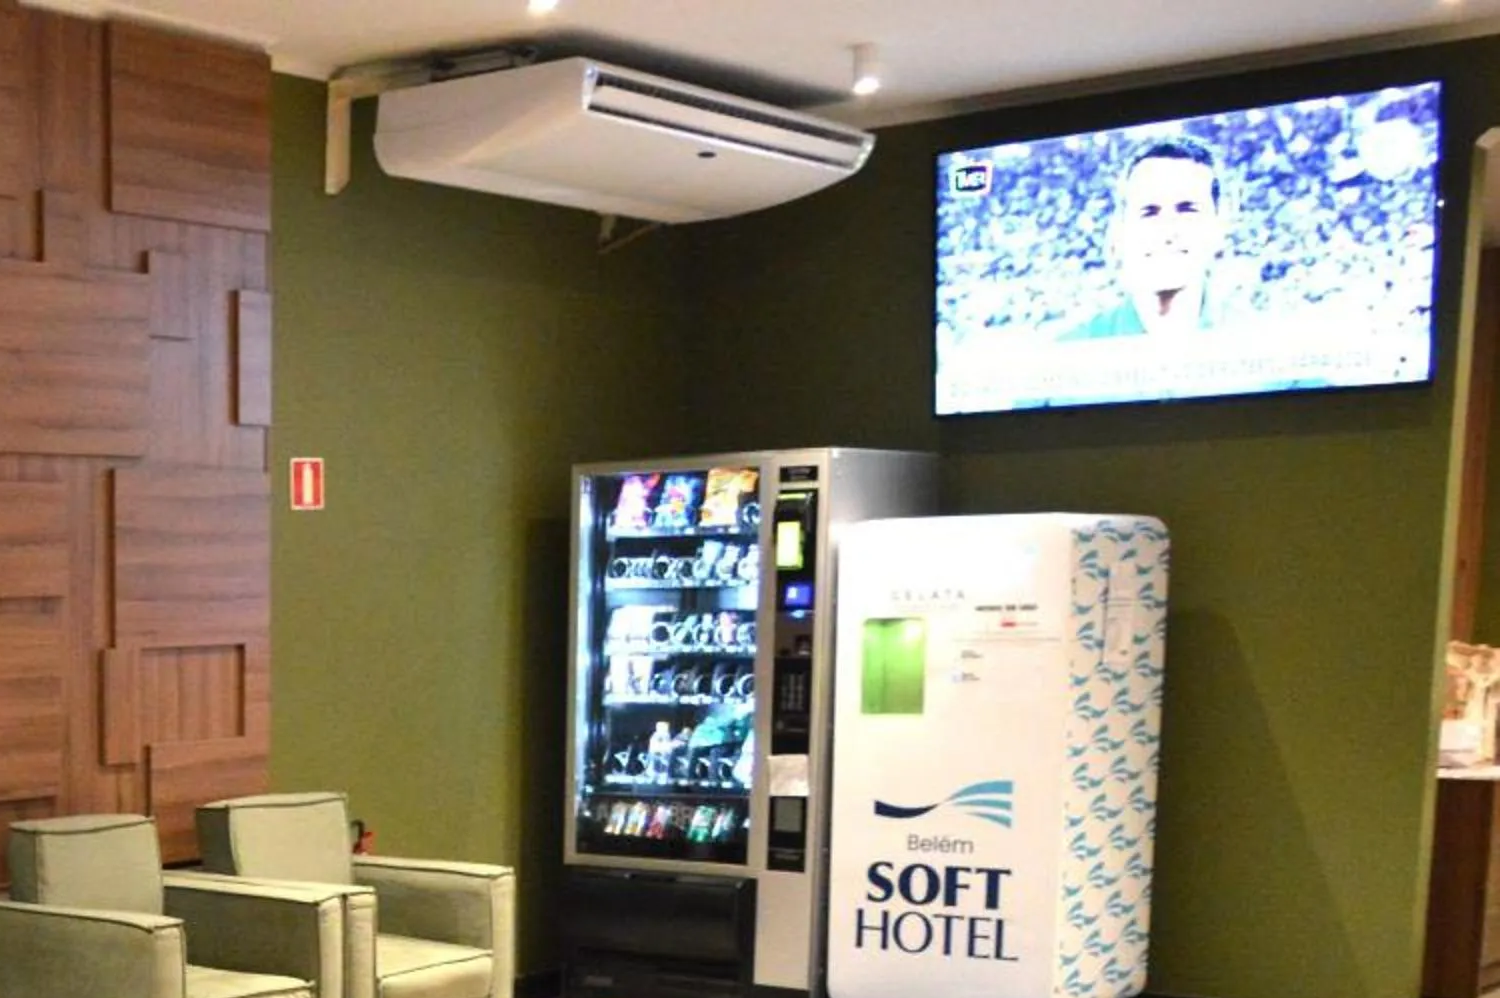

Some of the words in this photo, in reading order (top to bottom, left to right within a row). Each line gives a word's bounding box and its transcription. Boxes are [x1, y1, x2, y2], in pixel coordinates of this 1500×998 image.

[906, 833, 975, 854] Belém
[866, 860, 1013, 911] SOFT
[854, 908, 1020, 962] HOTEL
